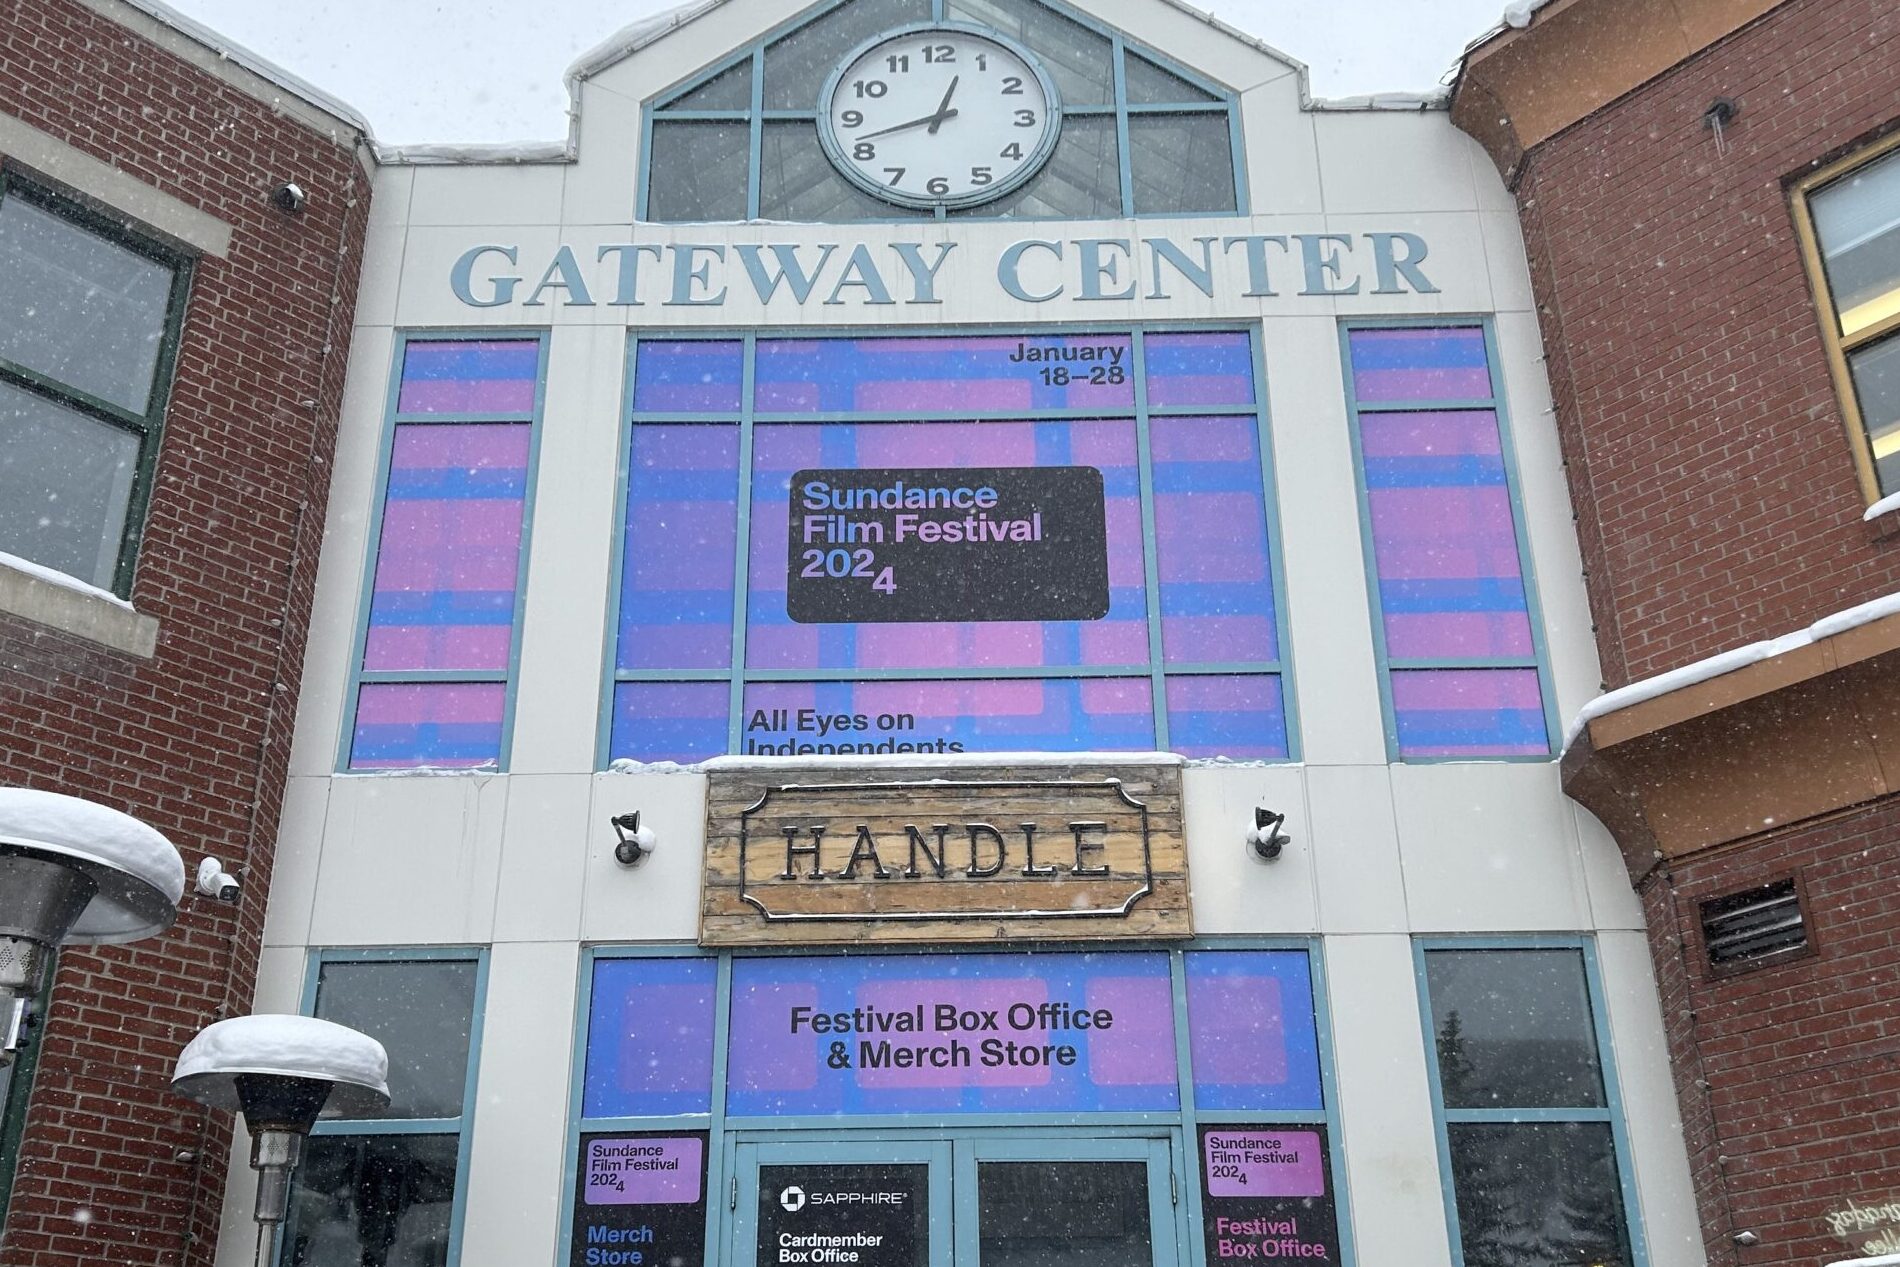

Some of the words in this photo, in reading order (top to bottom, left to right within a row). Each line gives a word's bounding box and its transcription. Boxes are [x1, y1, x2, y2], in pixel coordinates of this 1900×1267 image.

[922, 45, 956, 63] 12
[975, 53, 987, 72] 1
[886, 55, 909, 73] 11
[853, 80, 888, 98] 10
[1001, 77, 1024, 95] 2
[841, 110, 864, 128] 9
[1013, 109, 1036, 127] 3
[853, 142, 876, 161] 8
[1000, 142, 1023, 160] 4
[883, 168, 906, 186] 7
[971, 167, 993, 185] 5
[926, 177, 949, 196] 6
[450, 242, 958, 307] GATEWAY
[997, 232, 1442, 302] CENTER
[1009, 343, 1124, 365] January
[802, 481, 998, 510] Sundance
[803, 514, 884, 543] Film
[895, 512, 1042, 543] Festival
[800, 548, 897, 595] 2024
[748, 709, 787, 731] All
[797, 709, 868, 737] Eyes
[876, 713, 914, 731] on
[781, 821, 1110, 880] HANDLE
[791, 1004, 924, 1034] Festival
[934, 1004, 999, 1032] Box
[1007, 1002, 1113, 1031] Office
[827, 1041, 852, 1069] &
[860, 1039, 971, 1069] Merch
[980, 1038, 1076, 1067] Store
[592, 1144, 664, 1158] Sundance
[1210, 1136, 1282, 1150] Sundance
[592, 1158, 621, 1172] Film
[625, 1157, 679, 1171] Festival
[1211, 1151, 1241, 1164] Film
[1244, 1151, 1299, 1164] Festival
[590, 1173, 625, 1193] 2024
[1212, 1165, 1247, 1185] 2024
[587, 1224, 654, 1244] Merch
[1216, 1217, 1297, 1235] Festival
[779, 1232, 883, 1247] Cardmember
[1219, 1240, 1257, 1257] Box
[1263, 1239, 1326, 1258] Office
[585, 1247, 643, 1266] Store
[779, 1249, 809, 1263] Box
[811, 1248, 859, 1263] Office
